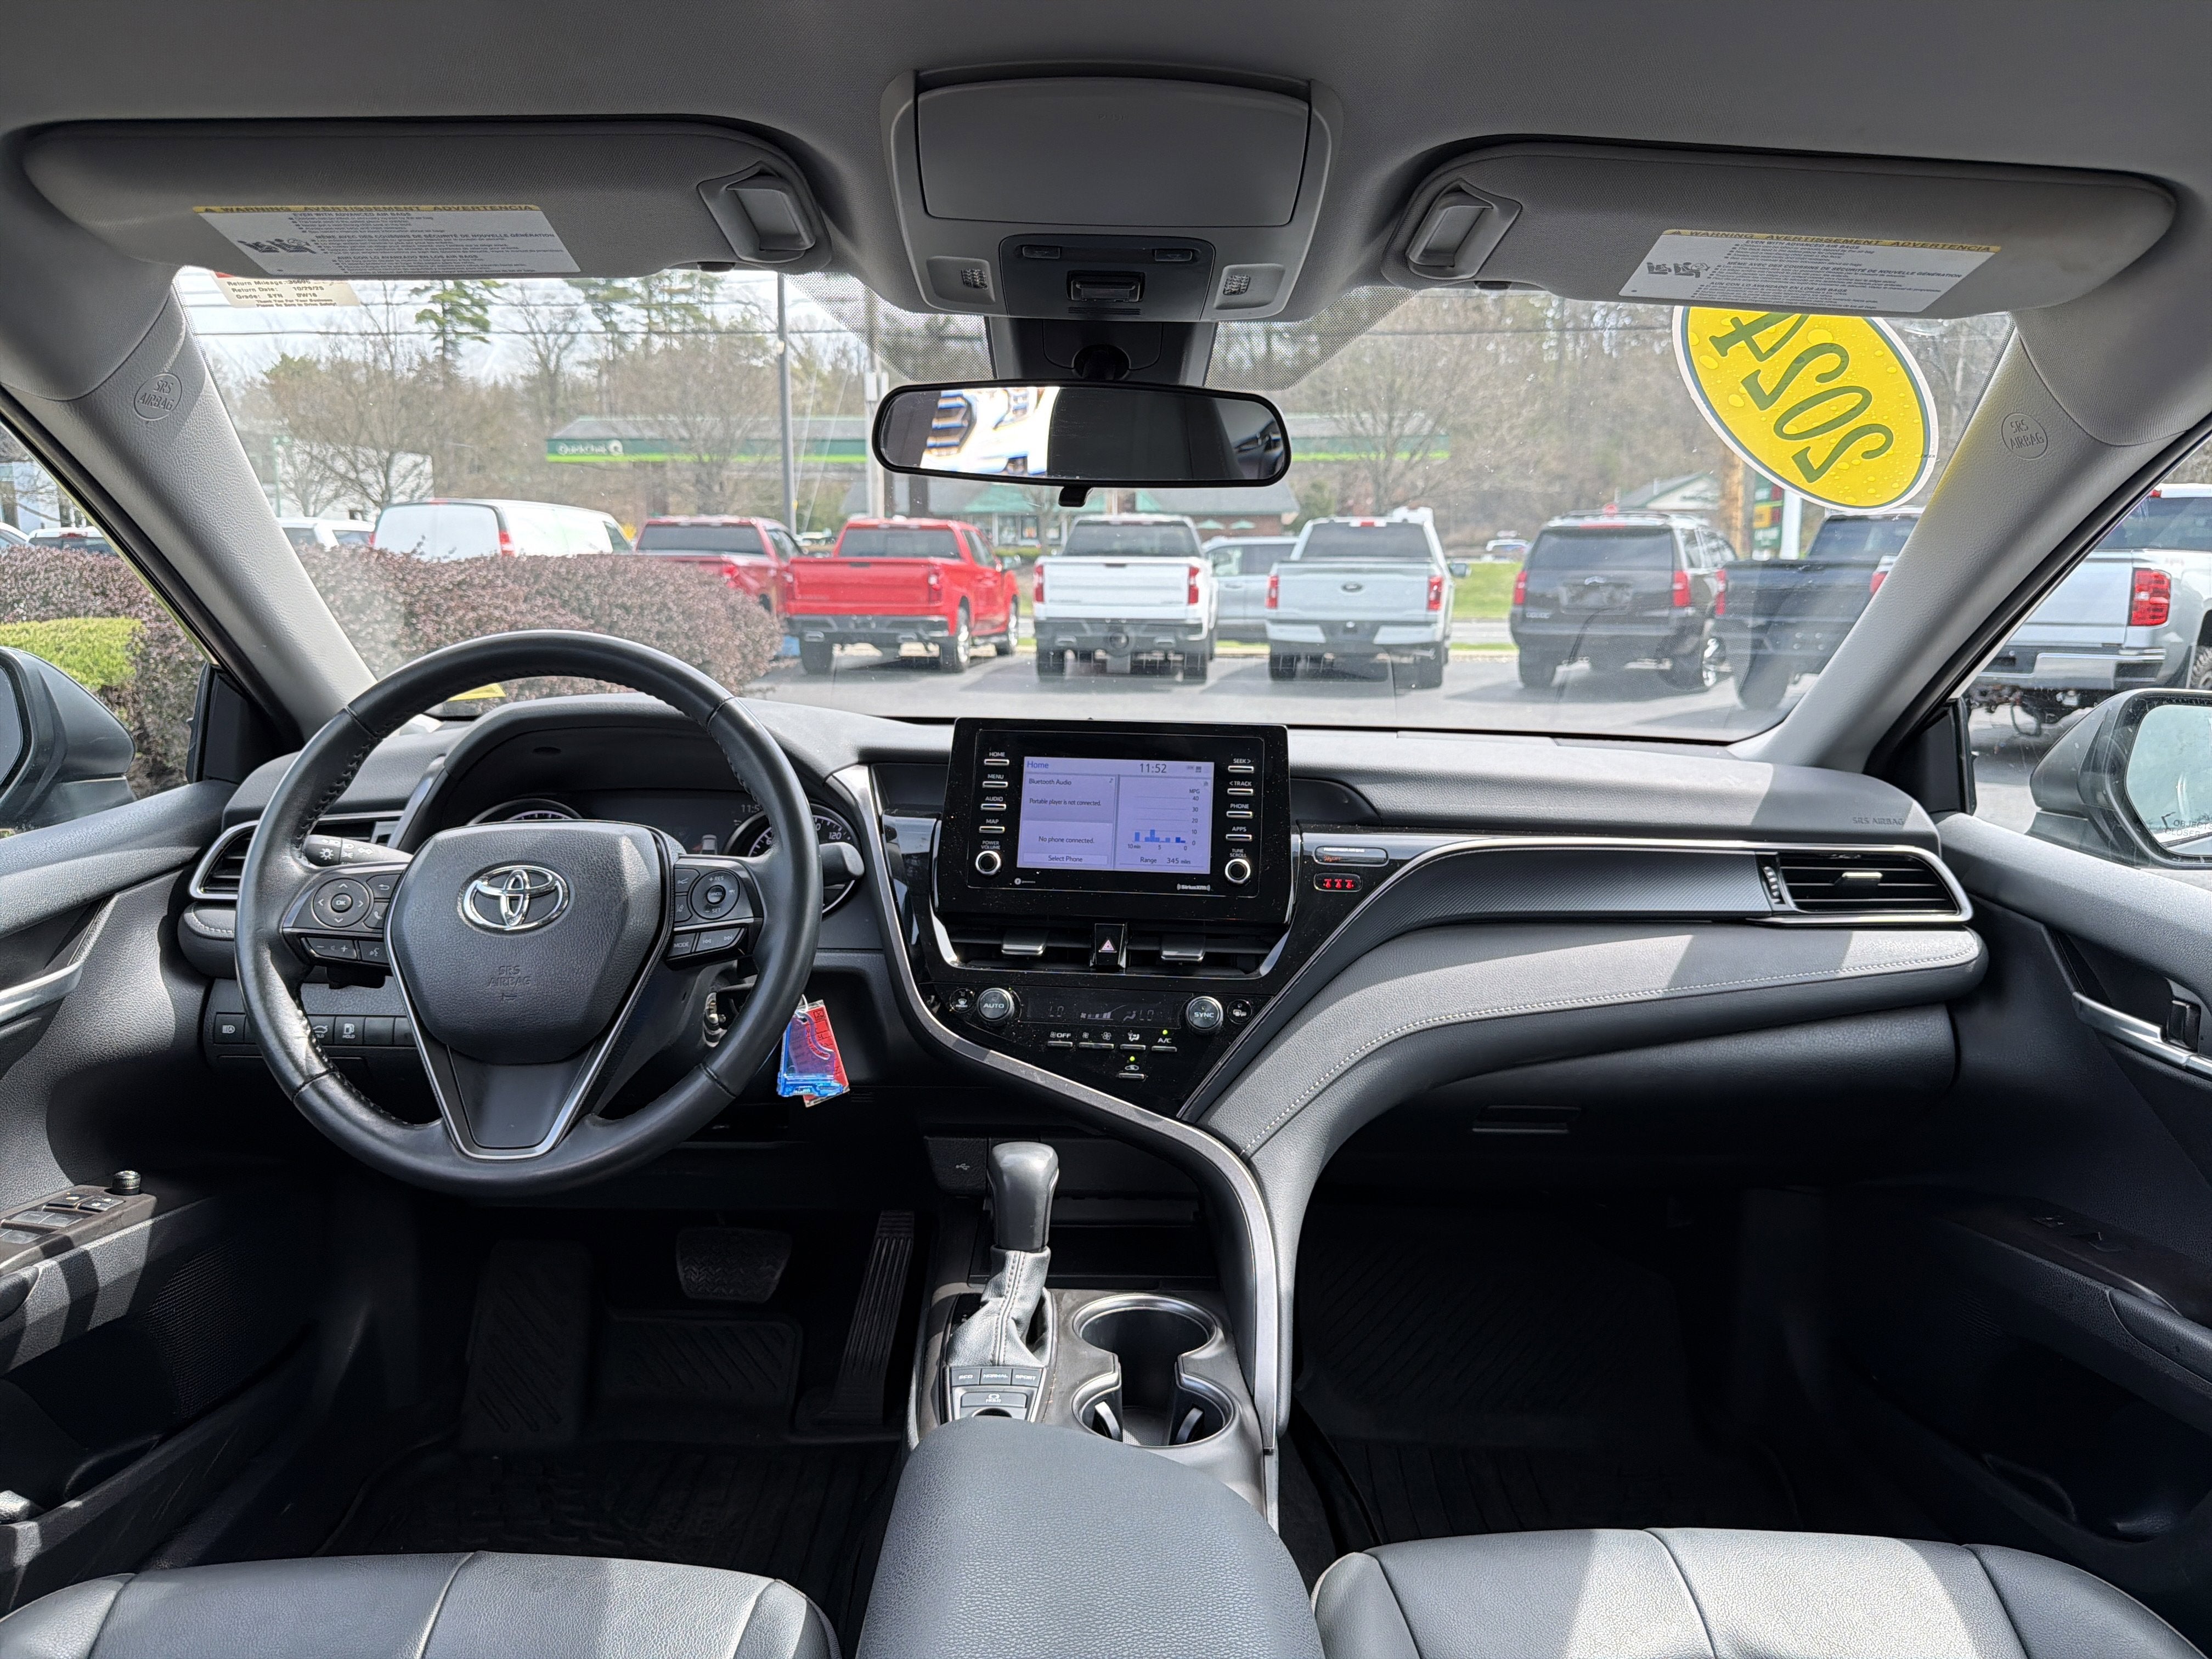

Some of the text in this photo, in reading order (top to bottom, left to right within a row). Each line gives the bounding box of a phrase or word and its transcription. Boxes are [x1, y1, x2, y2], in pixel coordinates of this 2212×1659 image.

[1690, 230, 1990, 251] WARNING AVERTISSEMENT ADVERTENCIA
[154, 380, 174, 394] SRS
[137, 392, 175, 411] AIRBAG
[2010, 419, 2029, 433] SRS
[2010, 432, 2045, 450] AIRBAG
[1026, 760, 1049, 769] Home
[1139, 763, 1167, 774] 11:52
[741, 804, 761, 812] 11:5
[1872, 817, 1904, 826] AIRBAG
[829, 832, 842, 840] 120
[2165, 827, 2200, 837] CLOSER
[499, 966, 520, 975] SRS
[489, 976, 531, 987] AIRBAG
[1048, 1006, 1064, 1018] LO
[1139, 1009, 1154, 1021] LO
